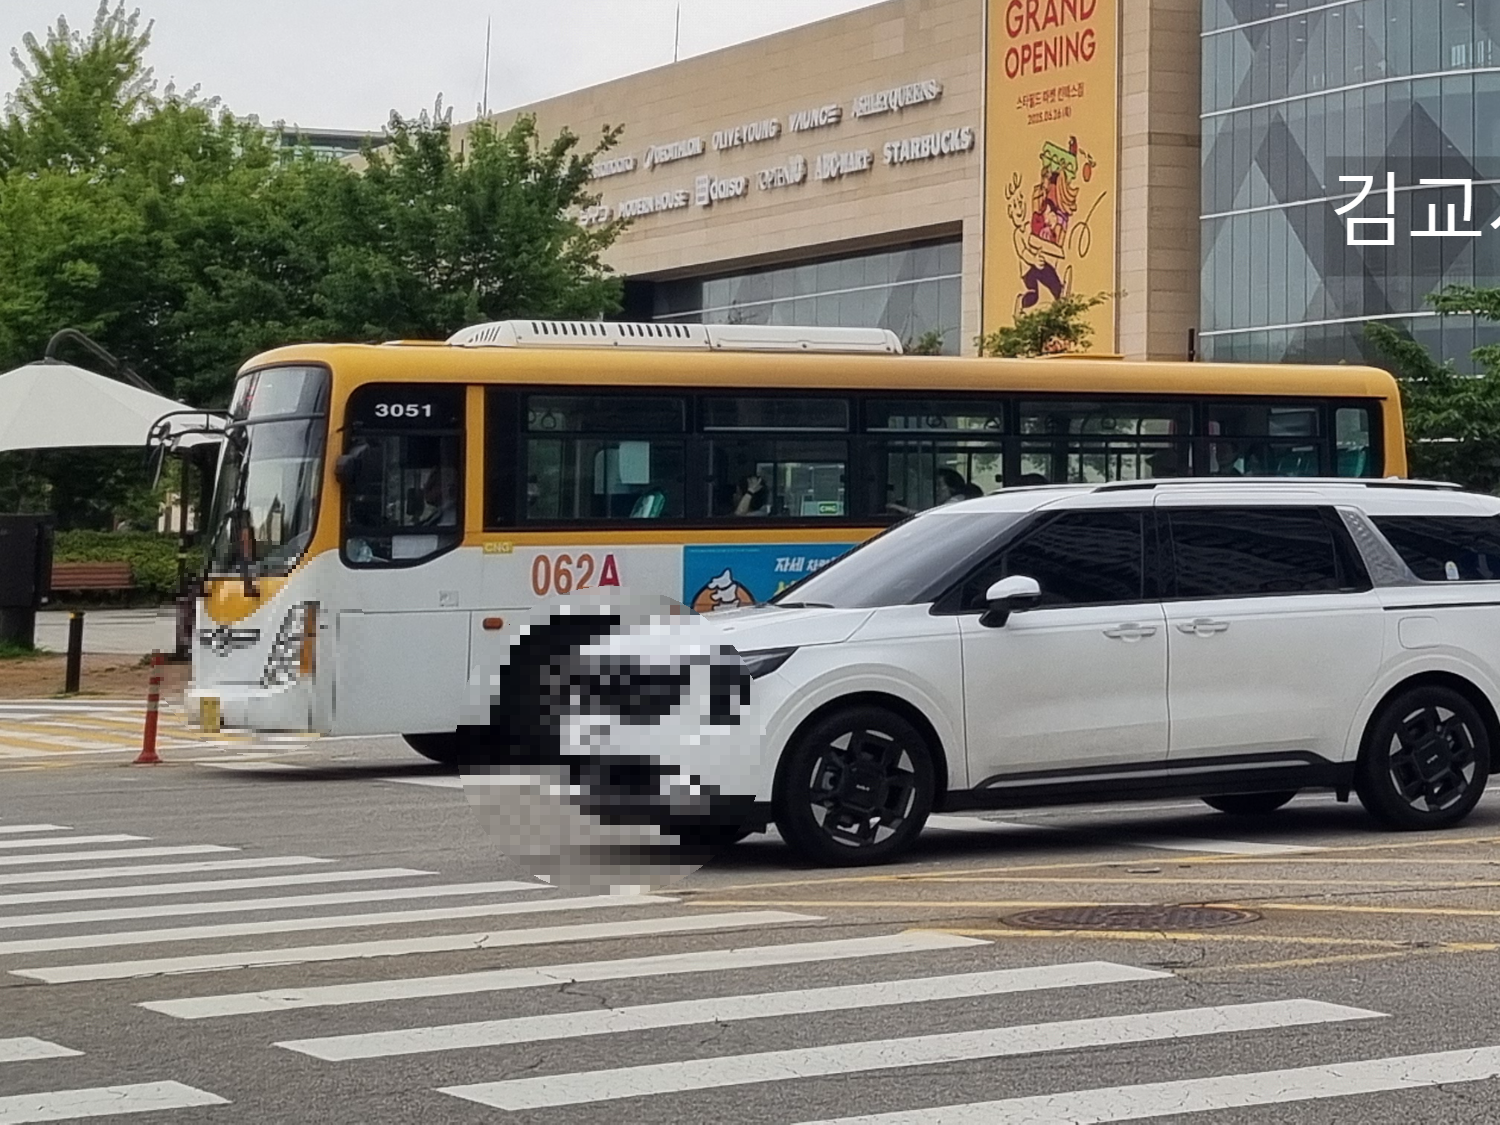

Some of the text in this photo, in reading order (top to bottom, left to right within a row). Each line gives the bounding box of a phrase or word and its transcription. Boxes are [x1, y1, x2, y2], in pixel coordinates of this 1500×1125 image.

[1005, 28, 1096, 79] OPENING
[883, 126, 973, 164] STARBUCKS
[374, 404, 432, 417] 3051
[532, 554, 620, 596] 062A
